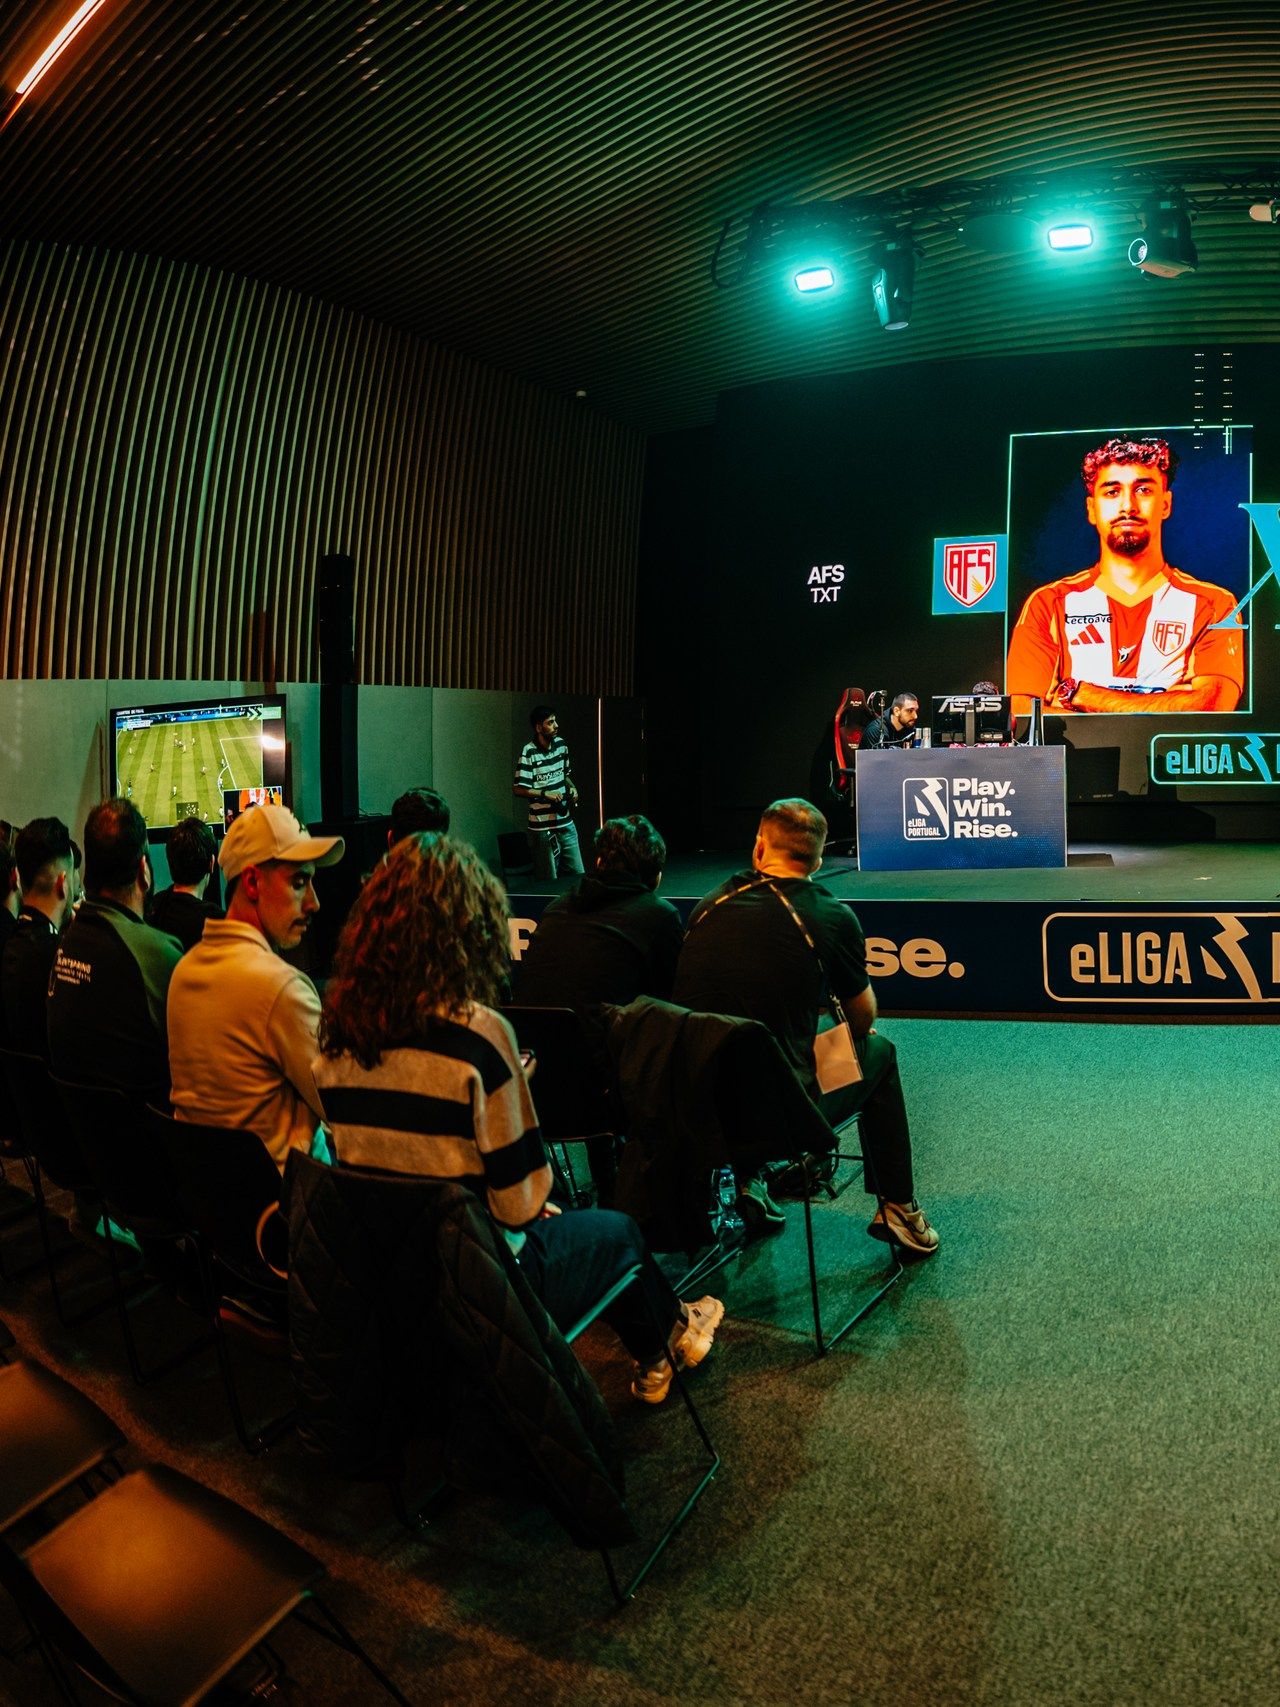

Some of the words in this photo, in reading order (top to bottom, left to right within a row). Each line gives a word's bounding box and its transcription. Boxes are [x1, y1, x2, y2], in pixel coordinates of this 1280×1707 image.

[807, 564, 845, 585] AFS
[950, 549, 990, 599] AFS
[810, 586, 841, 603] TXT
[1155, 622, 1184, 652] AFS
[1166, 743, 1234, 775] eLIGA
[953, 778, 1016, 799] Play.
[953, 797, 1012, 817] Win.
[907, 818, 926, 828] eLIGA
[907, 827, 941, 837] PORTUGAL
[953, 818, 1018, 839] Rise.
[864, 937, 965, 978] se.
[1070, 931, 1192, 984] eLIGA
